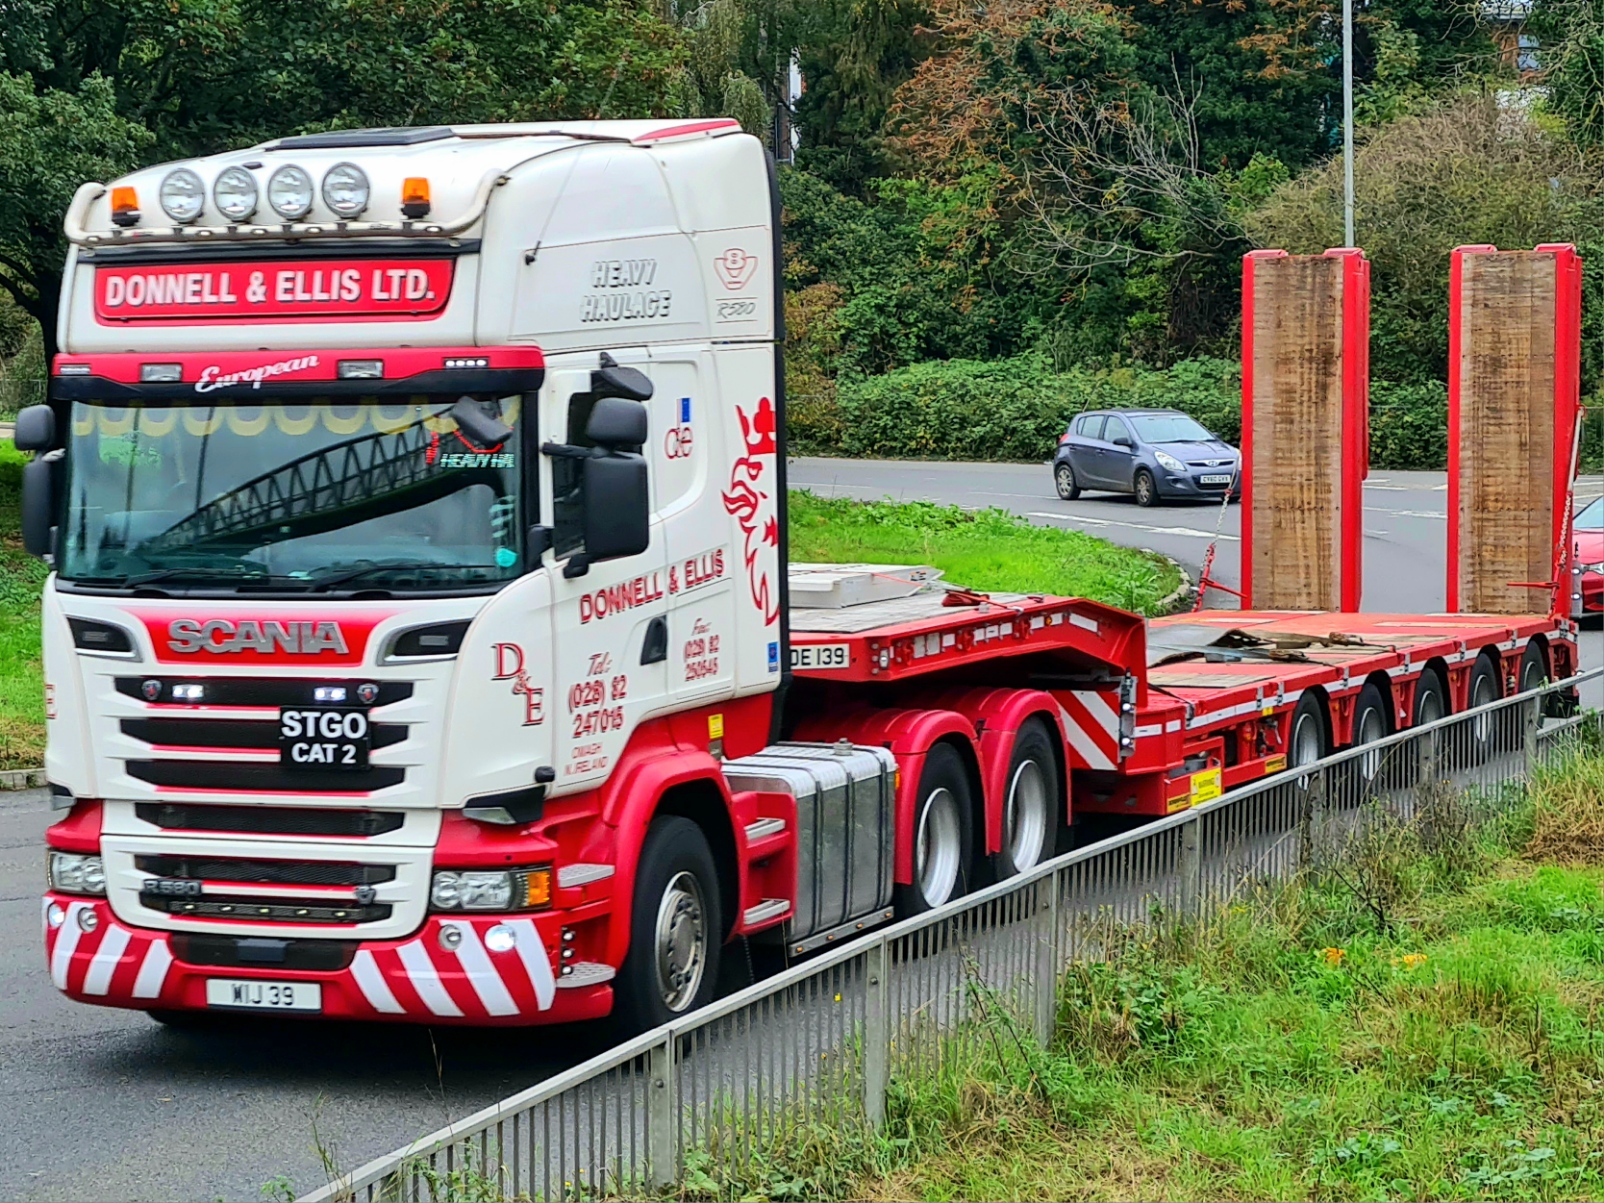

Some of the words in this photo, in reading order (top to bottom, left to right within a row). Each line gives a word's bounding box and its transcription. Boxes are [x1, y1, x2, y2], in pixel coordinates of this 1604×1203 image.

[105, 272, 237, 306] DONNELL
[245, 271, 268, 303] &
[275, 269, 361, 302] ELLIS
[371, 268, 435, 300] LTD.
[591, 258, 657, 288] HEAVY
[580, 290, 672, 323] HAULAGE
[194, 355, 320, 393] European
[440, 453, 491, 468] HEAVY
[580, 572, 664, 625] DONNELL
[669, 565, 680, 595] &
[684, 548, 724, 589] ELLIS
[167, 618, 349, 655] SCANIA
[490, 642, 525, 681] D
[586, 651, 613, 677] Tel:
[816, 647, 845, 665] 139
[521, 687, 546, 727] E
[569, 679, 606, 714] (028)
[611, 674, 628, 701] 82
[281, 710, 367, 740] STGO
[291, 743, 338, 763] CAT
[341, 744, 357, 764] 2
[231, 983, 263, 1005] WIJ
[268, 985, 295, 1006] 39
